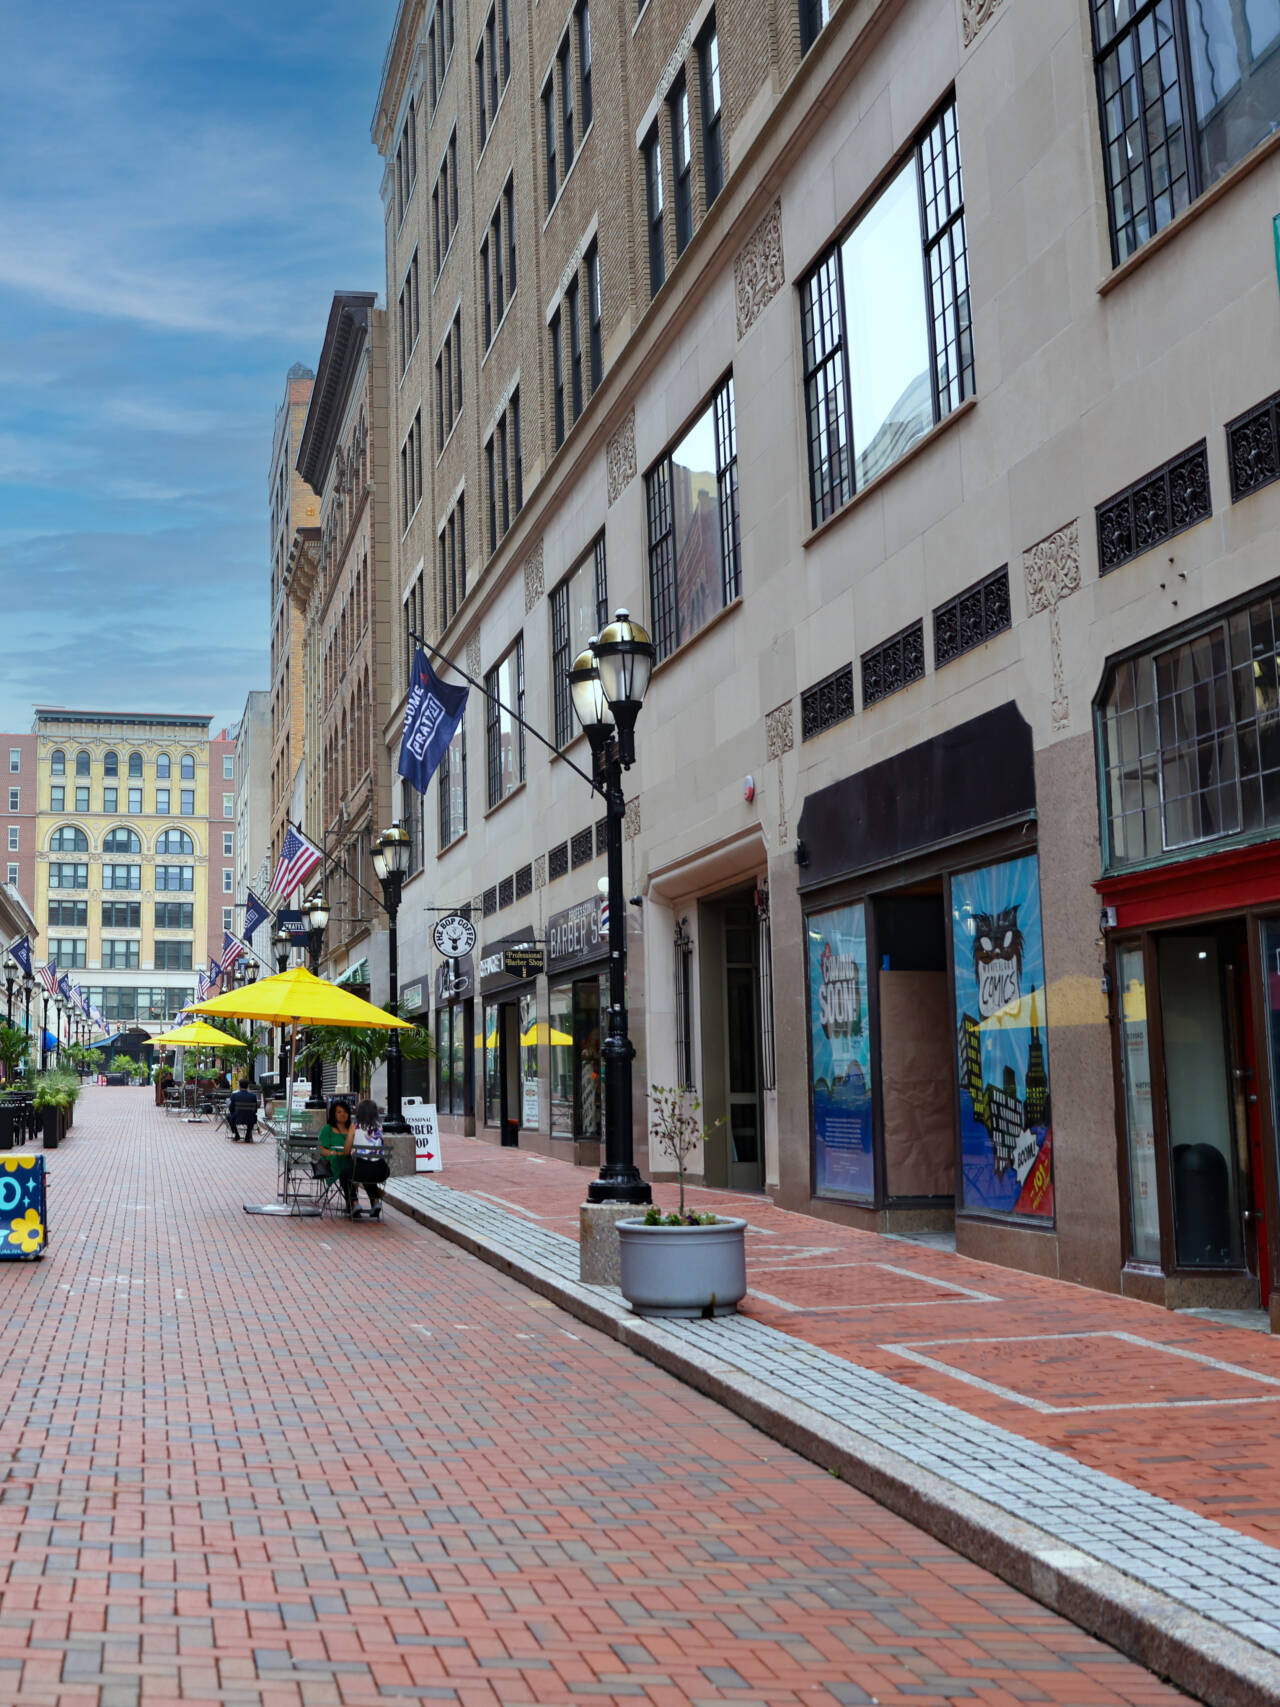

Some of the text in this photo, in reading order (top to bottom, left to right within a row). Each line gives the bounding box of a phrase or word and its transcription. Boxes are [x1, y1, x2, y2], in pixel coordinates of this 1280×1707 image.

[412, 709, 436, 754] PRATT
[436, 918, 474, 948] THE BOP COFFEE
[551, 917, 586, 958] BARBER
[506, 951, 542, 959] Professional
[528, 959, 544, 967] Shop
[982, 970, 1016, 1007] COMICS
[416, 1137, 429, 1149] OP
